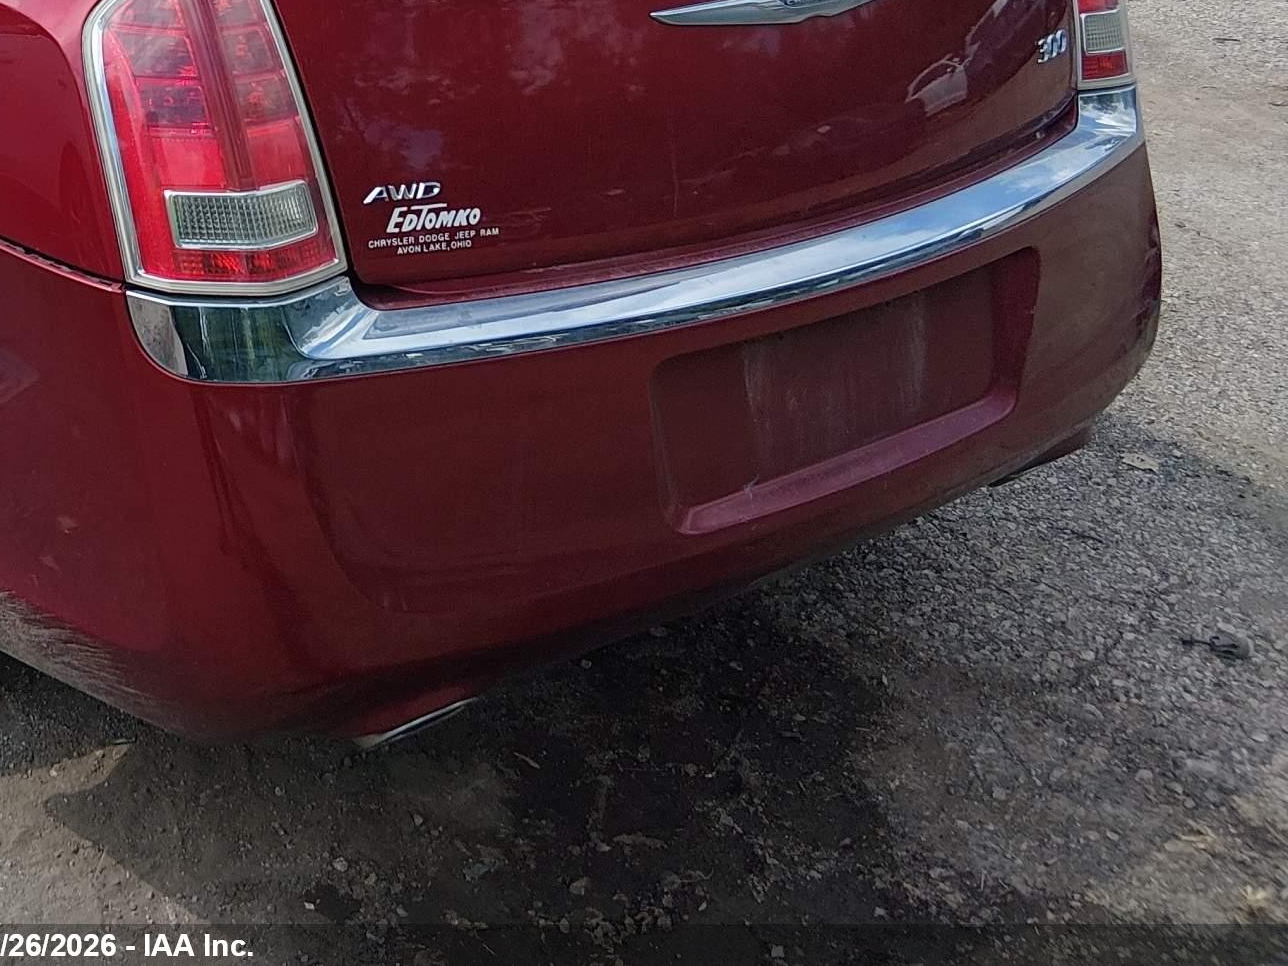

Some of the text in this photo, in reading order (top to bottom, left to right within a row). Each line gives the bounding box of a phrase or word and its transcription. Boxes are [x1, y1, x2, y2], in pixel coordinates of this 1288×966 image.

[1037, 29, 1067, 64] 300
[363, 181, 441, 205] AWD
[368, 227, 500, 249] CHRYSLER DODGE JEEP RAM
[396, 244, 421, 255] AVON
